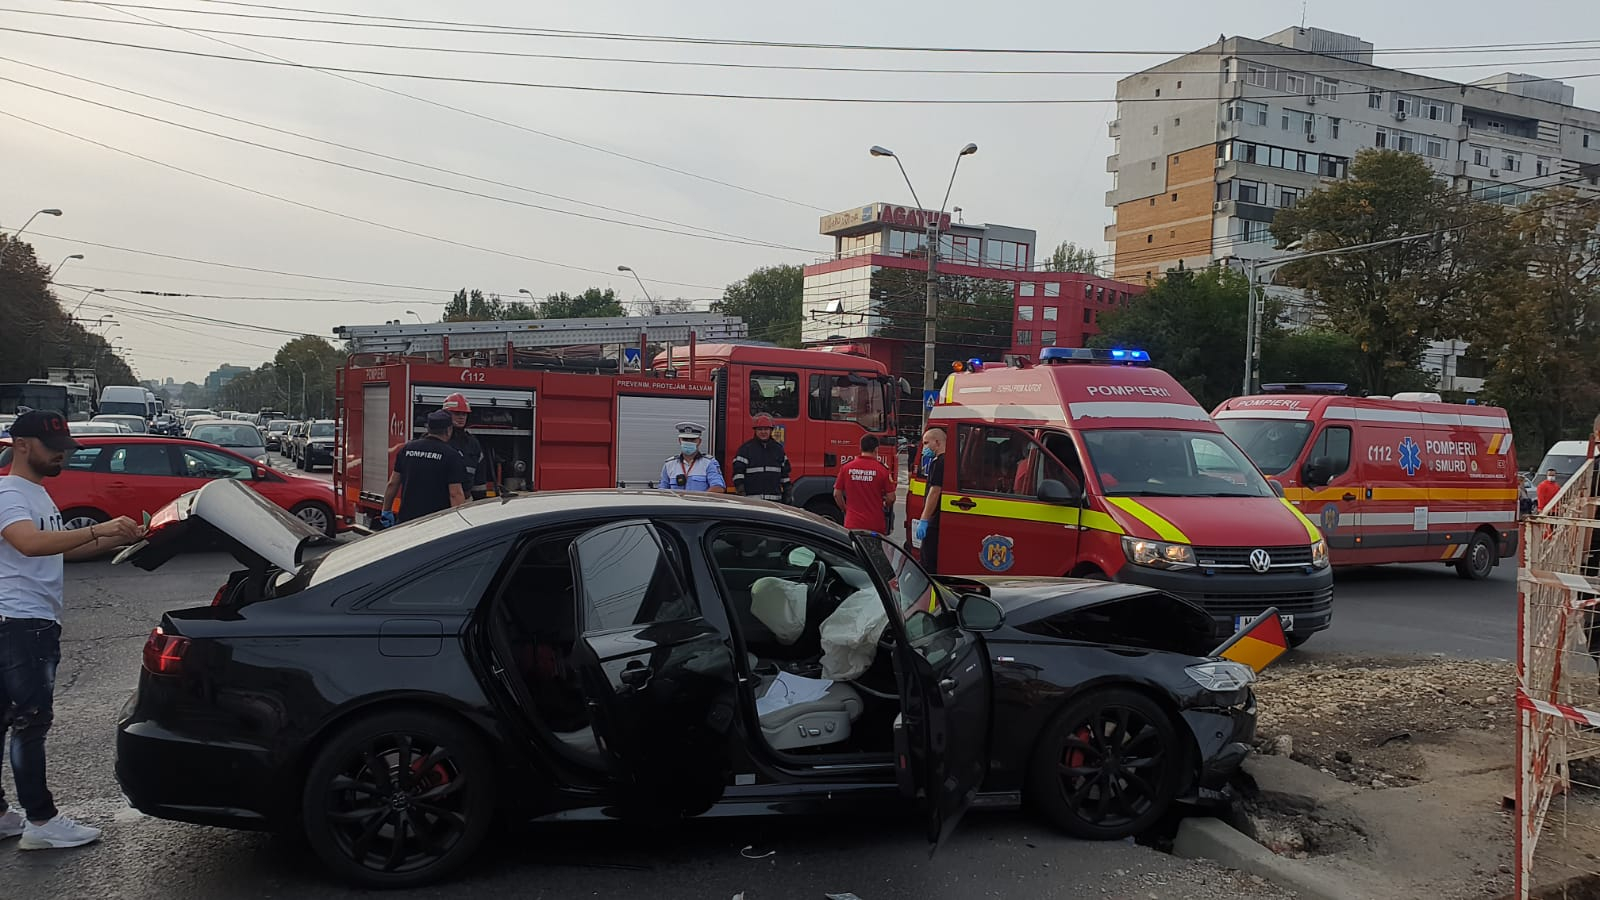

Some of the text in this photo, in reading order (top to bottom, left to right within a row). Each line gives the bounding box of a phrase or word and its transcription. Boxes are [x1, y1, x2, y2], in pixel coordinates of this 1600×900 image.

[1086, 386, 1171, 397] POMPIERII
[1237, 399, 1300, 409] POMPIERII
[1373, 445, 1392, 461] 112
[1426, 440, 1477, 456] POMPIERII
[405, 450, 443, 460] POMPIERII
[1435, 460, 1467, 472] SMURD
